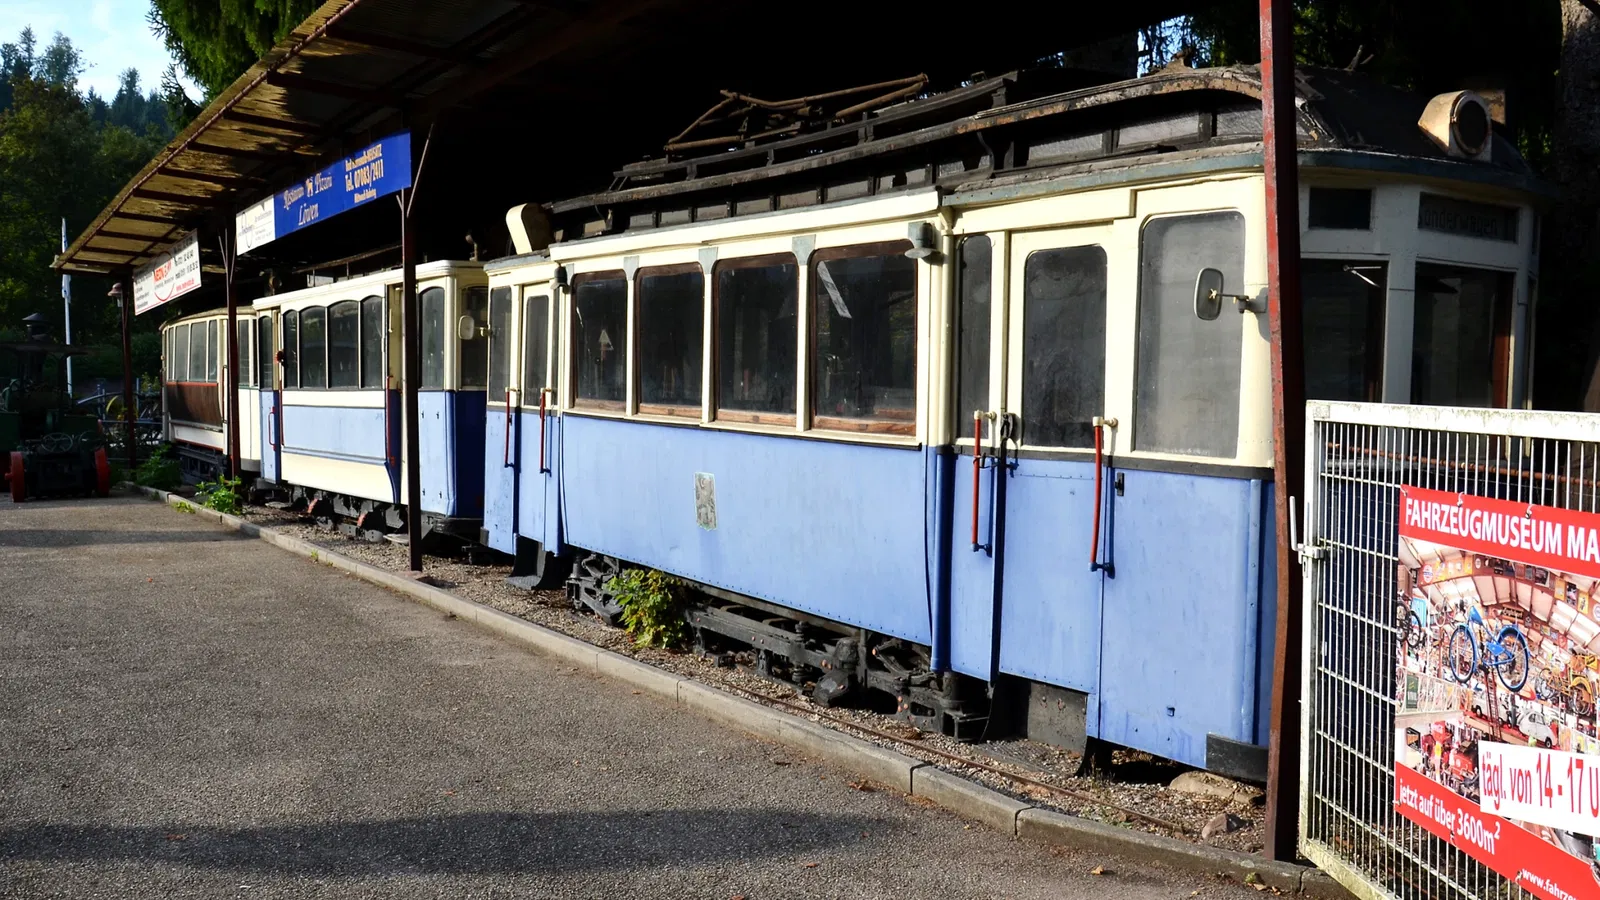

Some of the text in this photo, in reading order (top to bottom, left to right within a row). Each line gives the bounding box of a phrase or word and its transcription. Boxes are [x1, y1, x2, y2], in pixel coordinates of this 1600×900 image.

[345, 171, 354, 192] Tel.
[1405, 498, 1600, 564] FAHRZEUGMUSEUM MA
[1398, 779, 1418, 808] jetzt
[1419, 793, 1434, 818] auf
[1434, 797, 1456, 832] über
[1481, 751, 1506, 811] tägl.
[1509, 767, 1532, 805] von
[1536, 752, 1553, 809] 14
[1567, 756, 1584, 815] 17
[1522, 868, 1577, 900] www.fahrz
